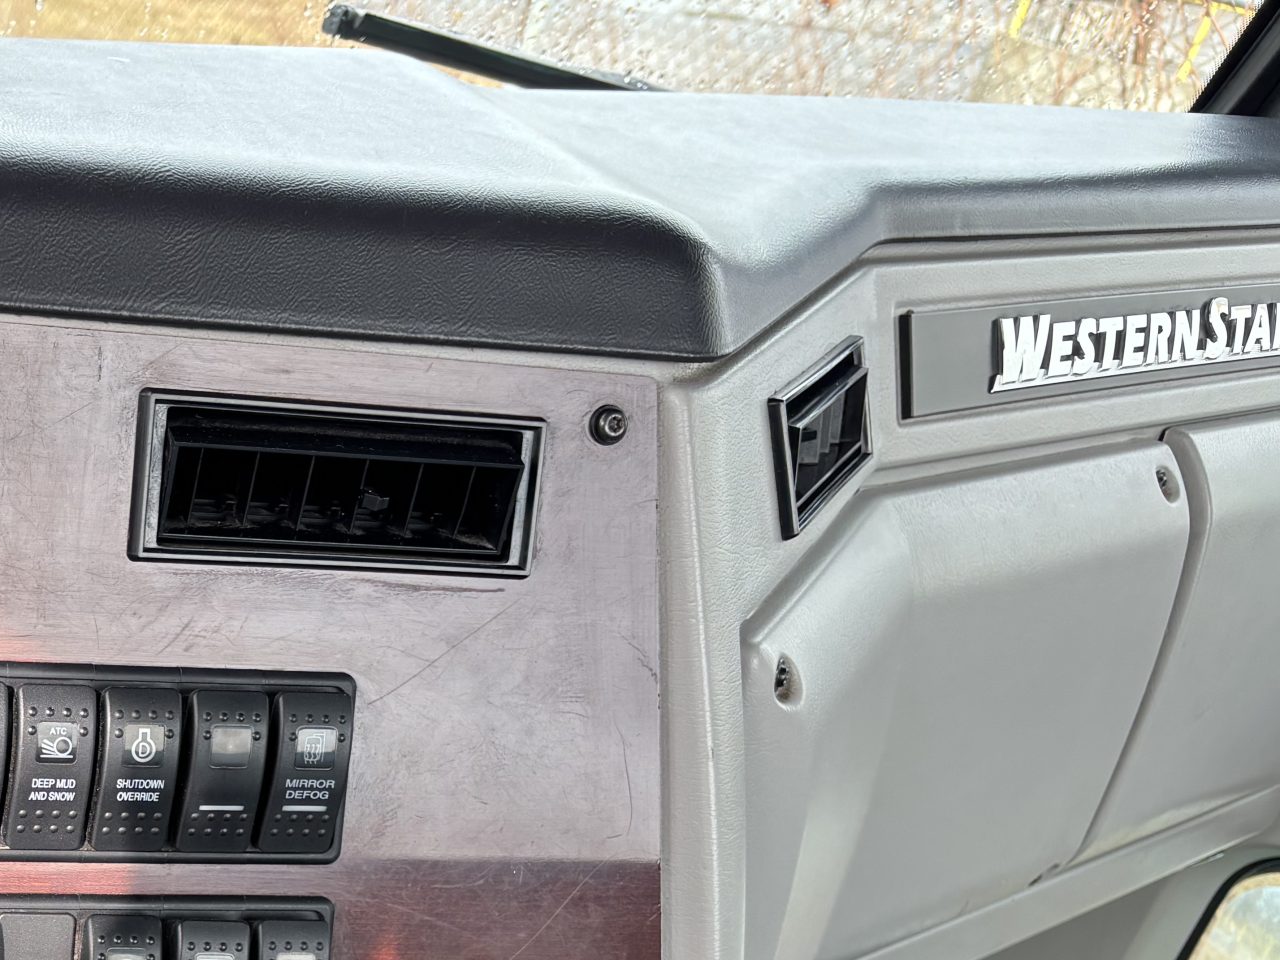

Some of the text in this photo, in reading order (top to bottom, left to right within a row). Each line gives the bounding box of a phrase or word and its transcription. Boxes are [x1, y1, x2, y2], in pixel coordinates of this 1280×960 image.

[49, 726, 67, 735] ATC
[31, 778, 76, 789] DEEP MUD
[116, 779, 165, 790] SHUTDOWN
[285, 778, 336, 789] MIRROR
[28, 791, 76, 801] AND SNOW
[116, 791, 160, 802] OVERRIDE
[285, 790, 329, 801] DEFOG
